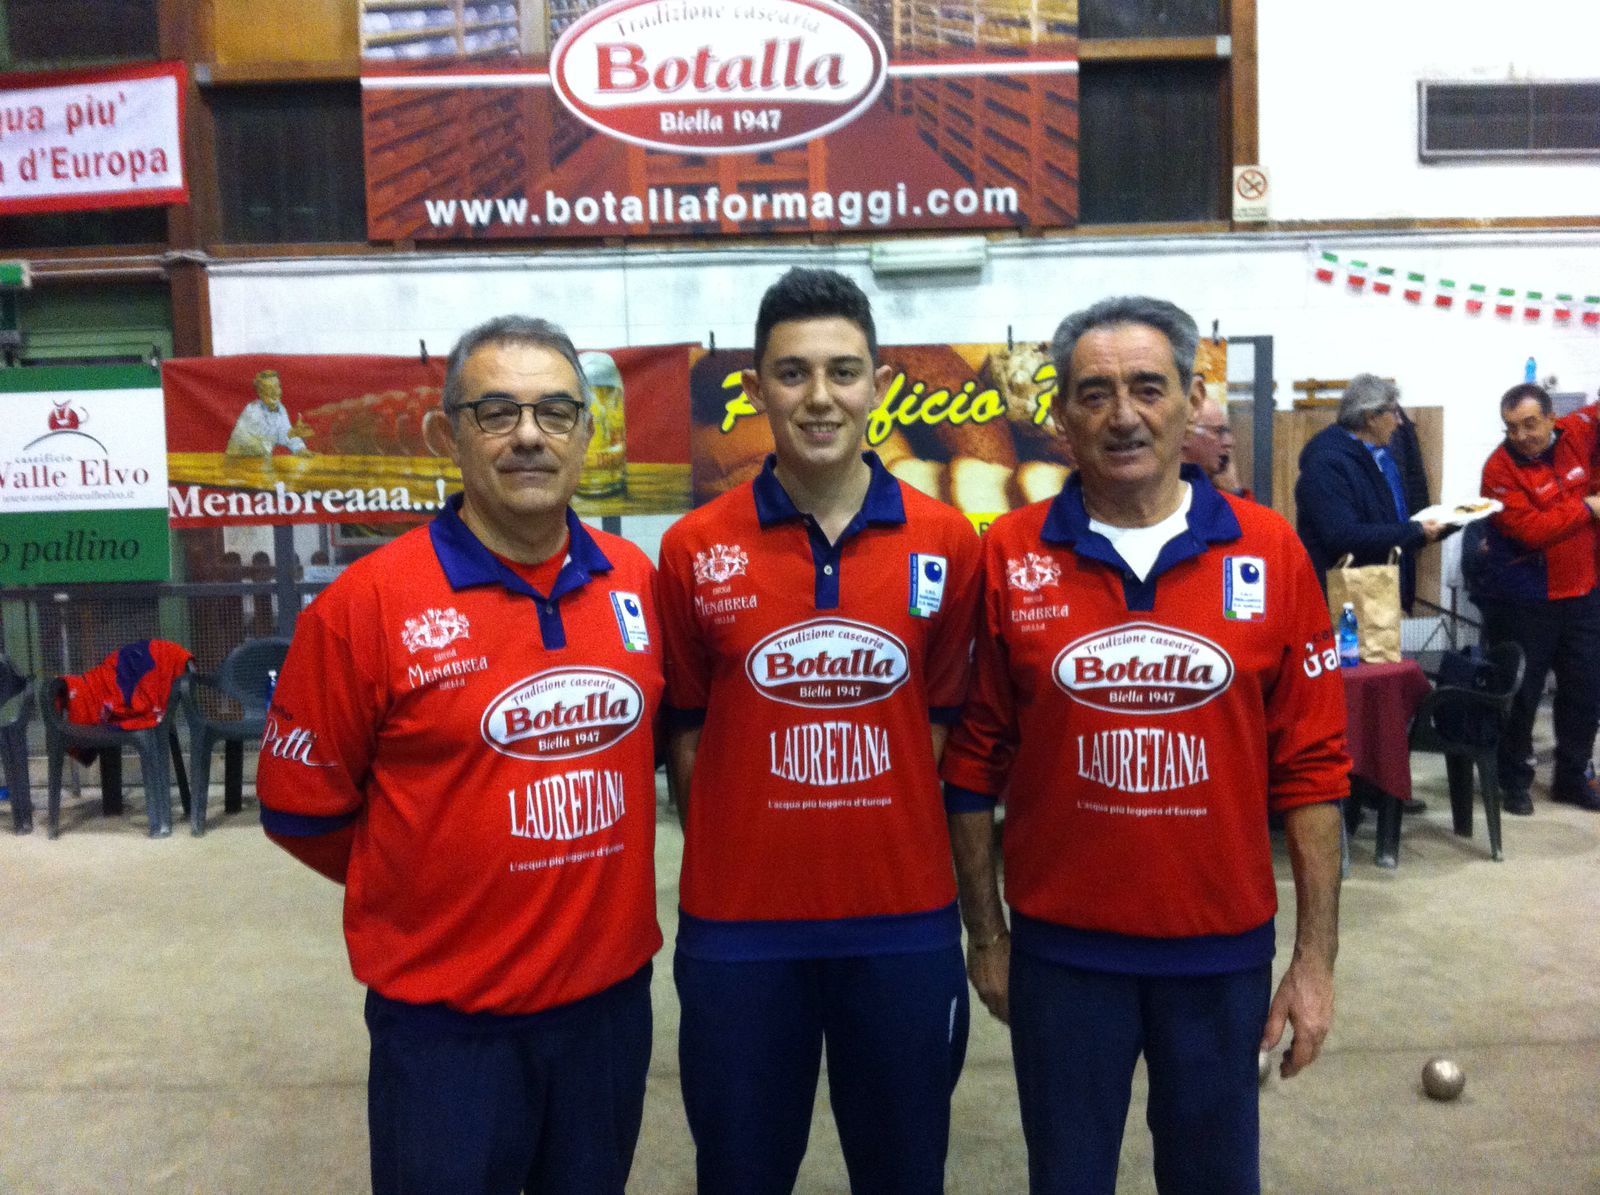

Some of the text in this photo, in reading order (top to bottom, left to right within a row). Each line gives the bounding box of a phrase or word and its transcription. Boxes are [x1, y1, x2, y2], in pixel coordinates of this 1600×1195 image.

[613, 1, 820, 36] Tradizione casearia
[594, 36, 848, 94] Botalla
[660, 108, 782, 133] Biella 1947
[18, 147, 168, 183] d'Europa
[425, 182, 1019, 226] www.botallaformaggi.com
[79, 459, 149, 487] Elvo
[168, 478, 446, 518] Menabreaaa..!
[20, 528, 140, 571] pallino
[775, 629, 884, 650] Tradizione casearia
[1084, 634, 1200, 655] Tradizione casearia
[765, 648, 895, 681] Botalla
[1072, 654, 1214, 685] Botalla
[511, 677, 616, 706] Tradizione casearia
[800, 685, 862, 698] Biella 1947
[1109, 690, 1176, 703] Biella 1947
[503, 691, 630, 738] Botalla
[538, 731, 600, 751] Biella 1947
[769, 720, 891, 786] LAURETANA
[1078, 727, 1209, 793] LAURETANA
[508, 768, 625, 841] LAURETANA
